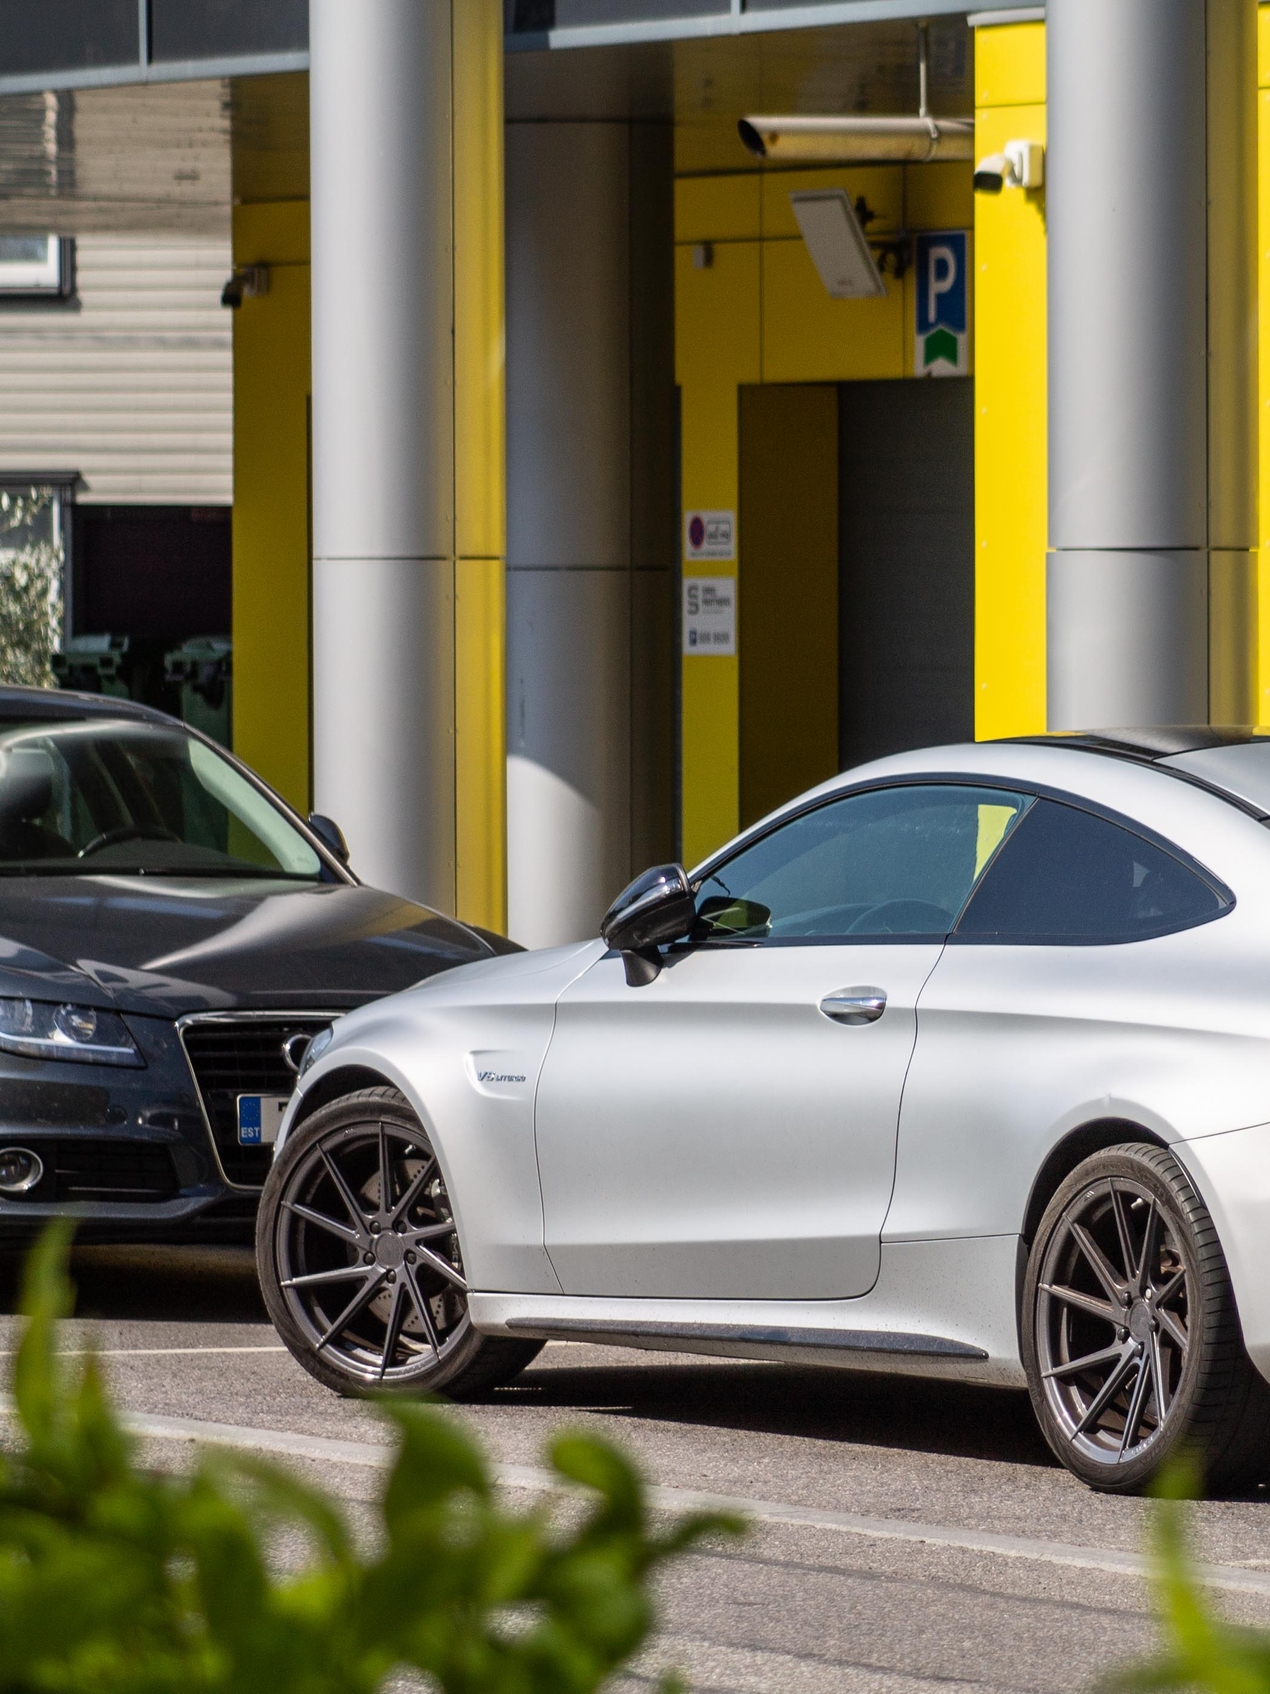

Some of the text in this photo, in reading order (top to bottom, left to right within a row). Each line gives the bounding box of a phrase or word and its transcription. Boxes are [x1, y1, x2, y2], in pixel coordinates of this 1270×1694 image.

[928, 246, 957, 323] P
[478, 1071, 496, 1081] V8
[241, 1127, 260, 1138] EST
